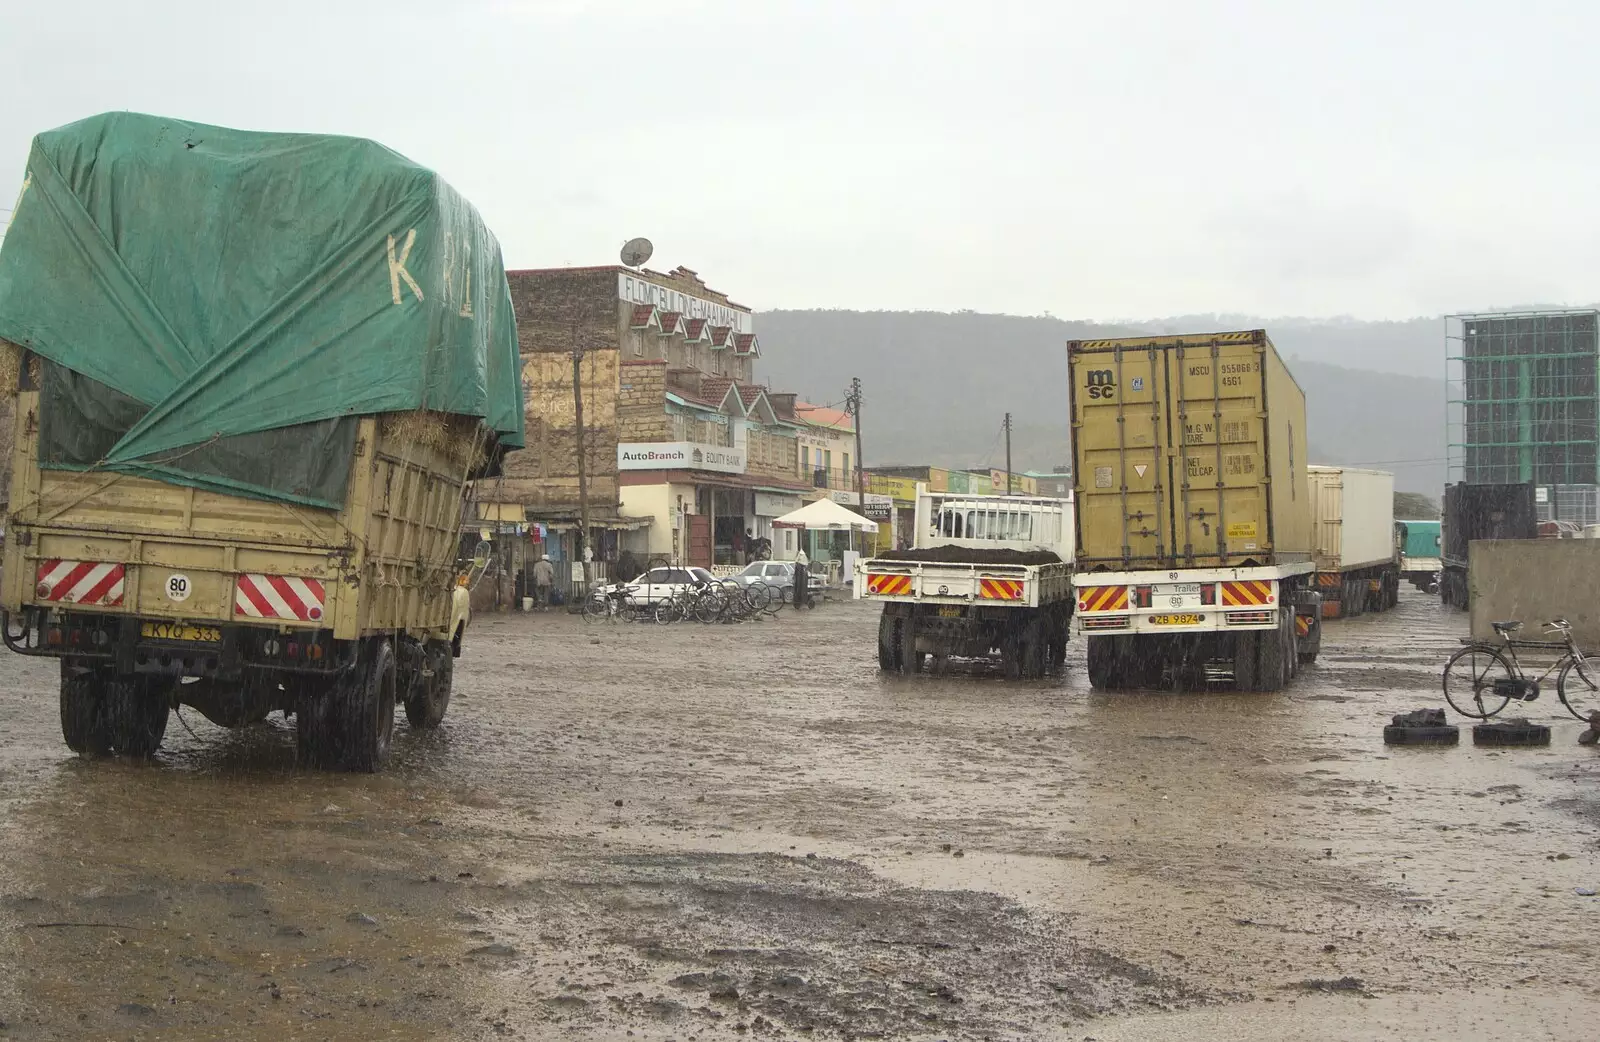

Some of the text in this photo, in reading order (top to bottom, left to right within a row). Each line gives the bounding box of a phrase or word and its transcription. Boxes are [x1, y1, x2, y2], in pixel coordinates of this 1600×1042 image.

[1189, 366, 1210, 376] MSCU
[1222, 376, 1242, 386] 45G1
[1186, 434, 1204, 444] TARE
[622, 451, 684, 461] AutoBranch
[706, 452, 741, 467] EQUITY BANK
[1187, 457, 1200, 467] NET
[1168, 572, 1179, 580] 80
[170, 578, 187, 591] 80
[1173, 585, 1200, 593] Trailer
[1156, 614, 1198, 624] ZB 9874
